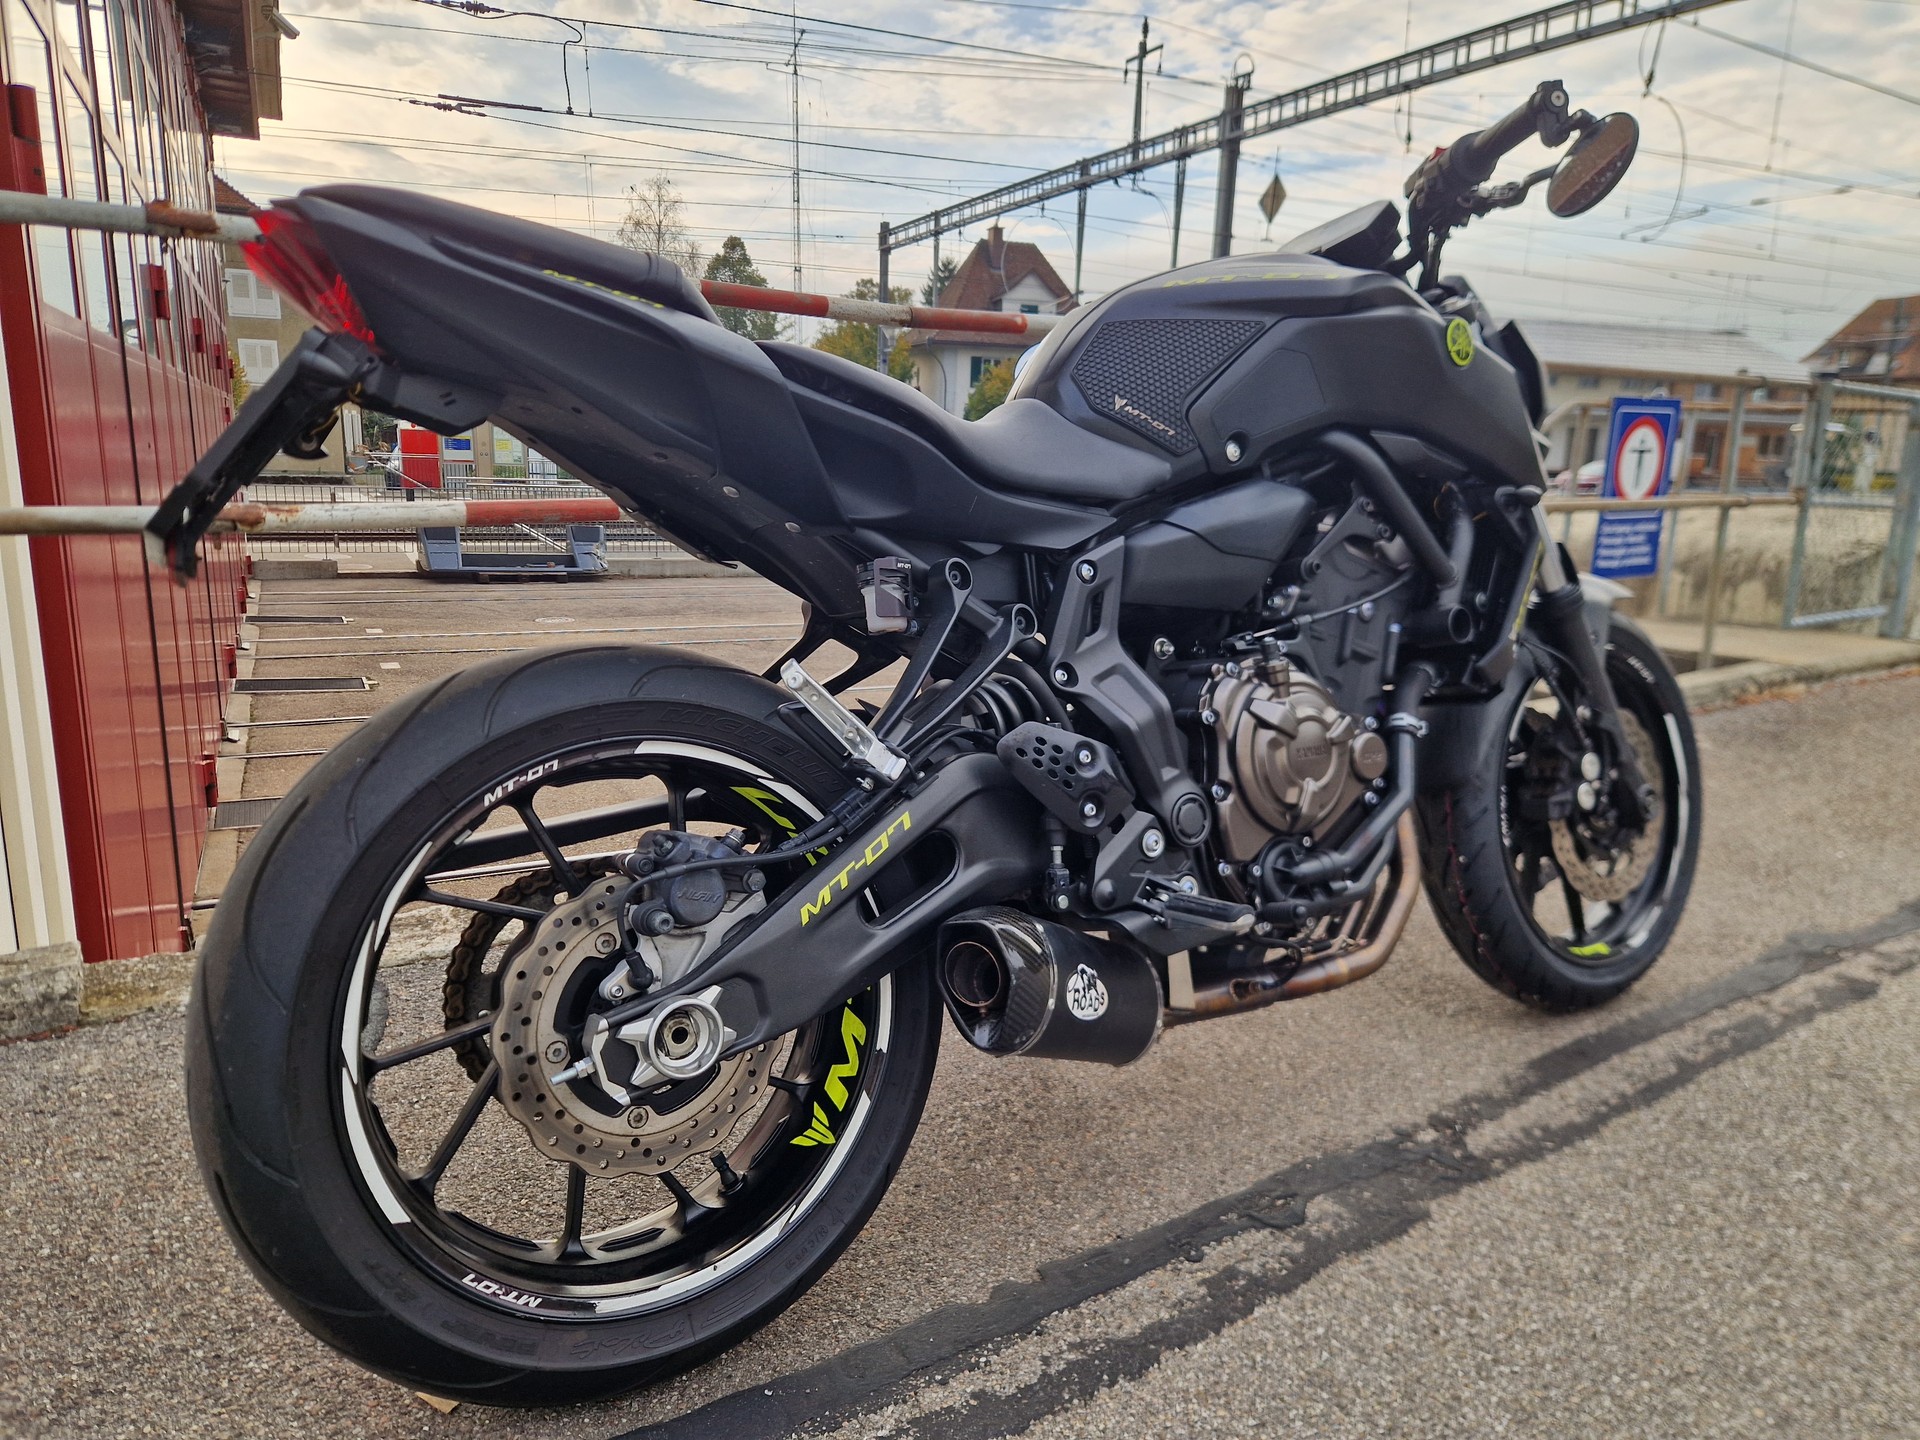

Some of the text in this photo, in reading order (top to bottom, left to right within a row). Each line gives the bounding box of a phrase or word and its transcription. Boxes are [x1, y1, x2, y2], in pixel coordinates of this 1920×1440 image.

[1124, 404, 1176, 436] MT-07
[483, 758, 560, 807] MT-07
[800, 811, 912, 928] MT-07
[461, 1273, 543, 1308] MT-07
